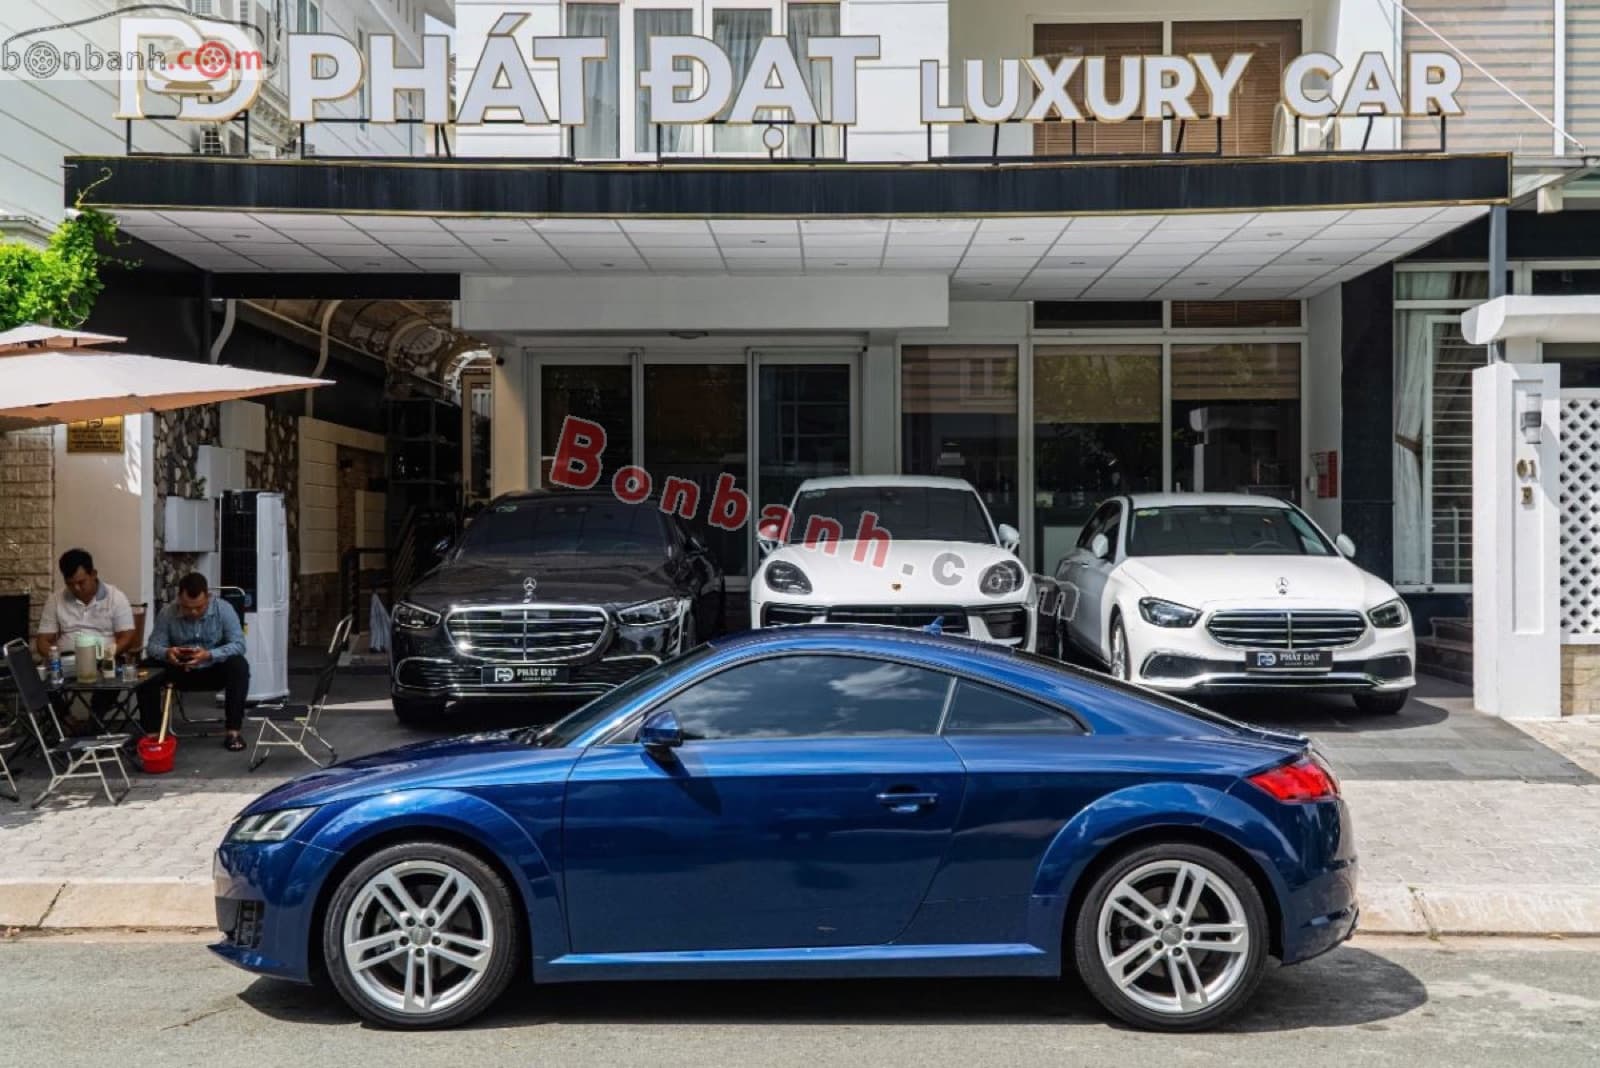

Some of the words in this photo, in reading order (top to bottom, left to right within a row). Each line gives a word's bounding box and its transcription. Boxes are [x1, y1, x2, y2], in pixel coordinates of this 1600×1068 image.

[287, 12, 608, 126] PHÁT
[638, 34, 881, 150] ĐẠT
[919, 50, 1254, 123] LUXURY
[1280, 50, 1466, 118] CAR
